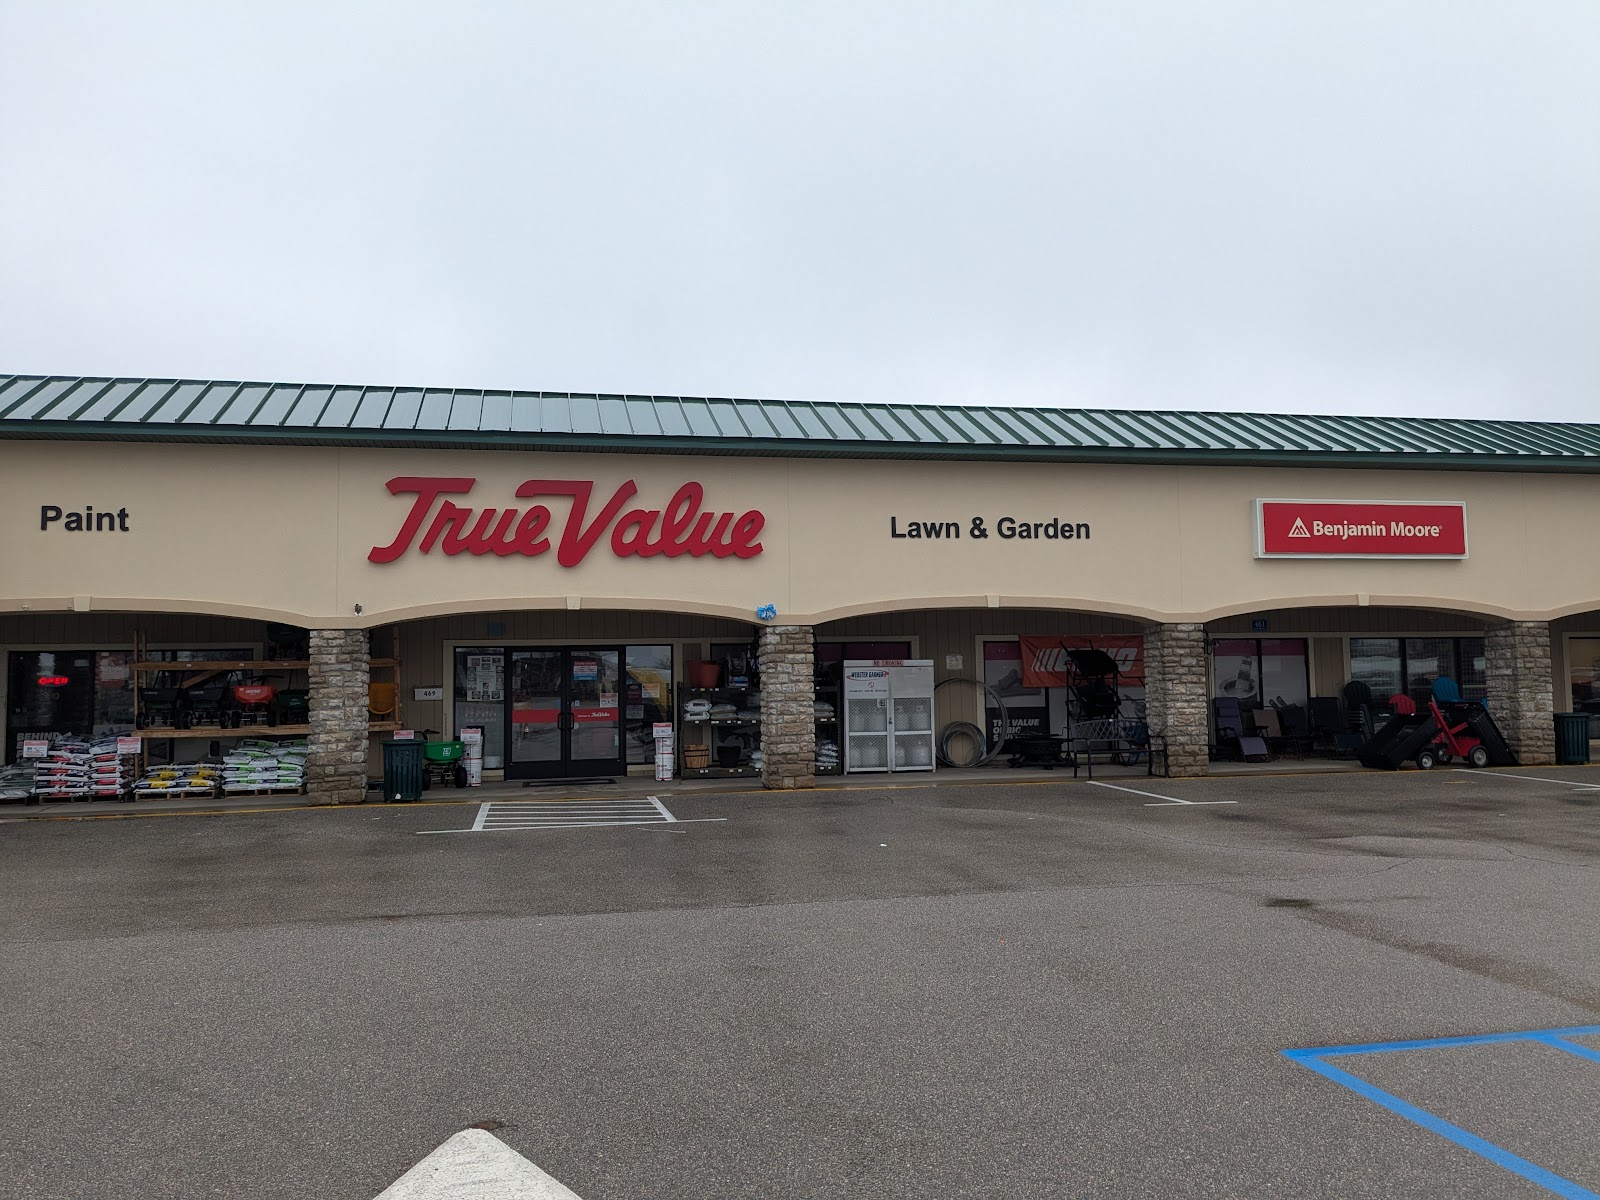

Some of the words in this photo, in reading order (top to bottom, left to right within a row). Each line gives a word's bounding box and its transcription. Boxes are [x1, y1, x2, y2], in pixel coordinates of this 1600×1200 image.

[40, 505, 130, 532] Paint
[367, 476, 552, 564] True
[515, 478, 766, 568] Value
[890, 516, 960, 539] Lawn
[969, 516, 989, 539] &
[997, 516, 1091, 540] Garden
[1313, 520, 1386, 540] Benjamin
[1390, 521, 1440, 537] Moore
[1053, 647, 1138, 672] EO
[38, 676, 69, 686] OPEN
[1006, 726, 1022, 734] BIG
[1011, 718, 1040, 727] VALUE
[16, 731, 62, 741] BEHIND
